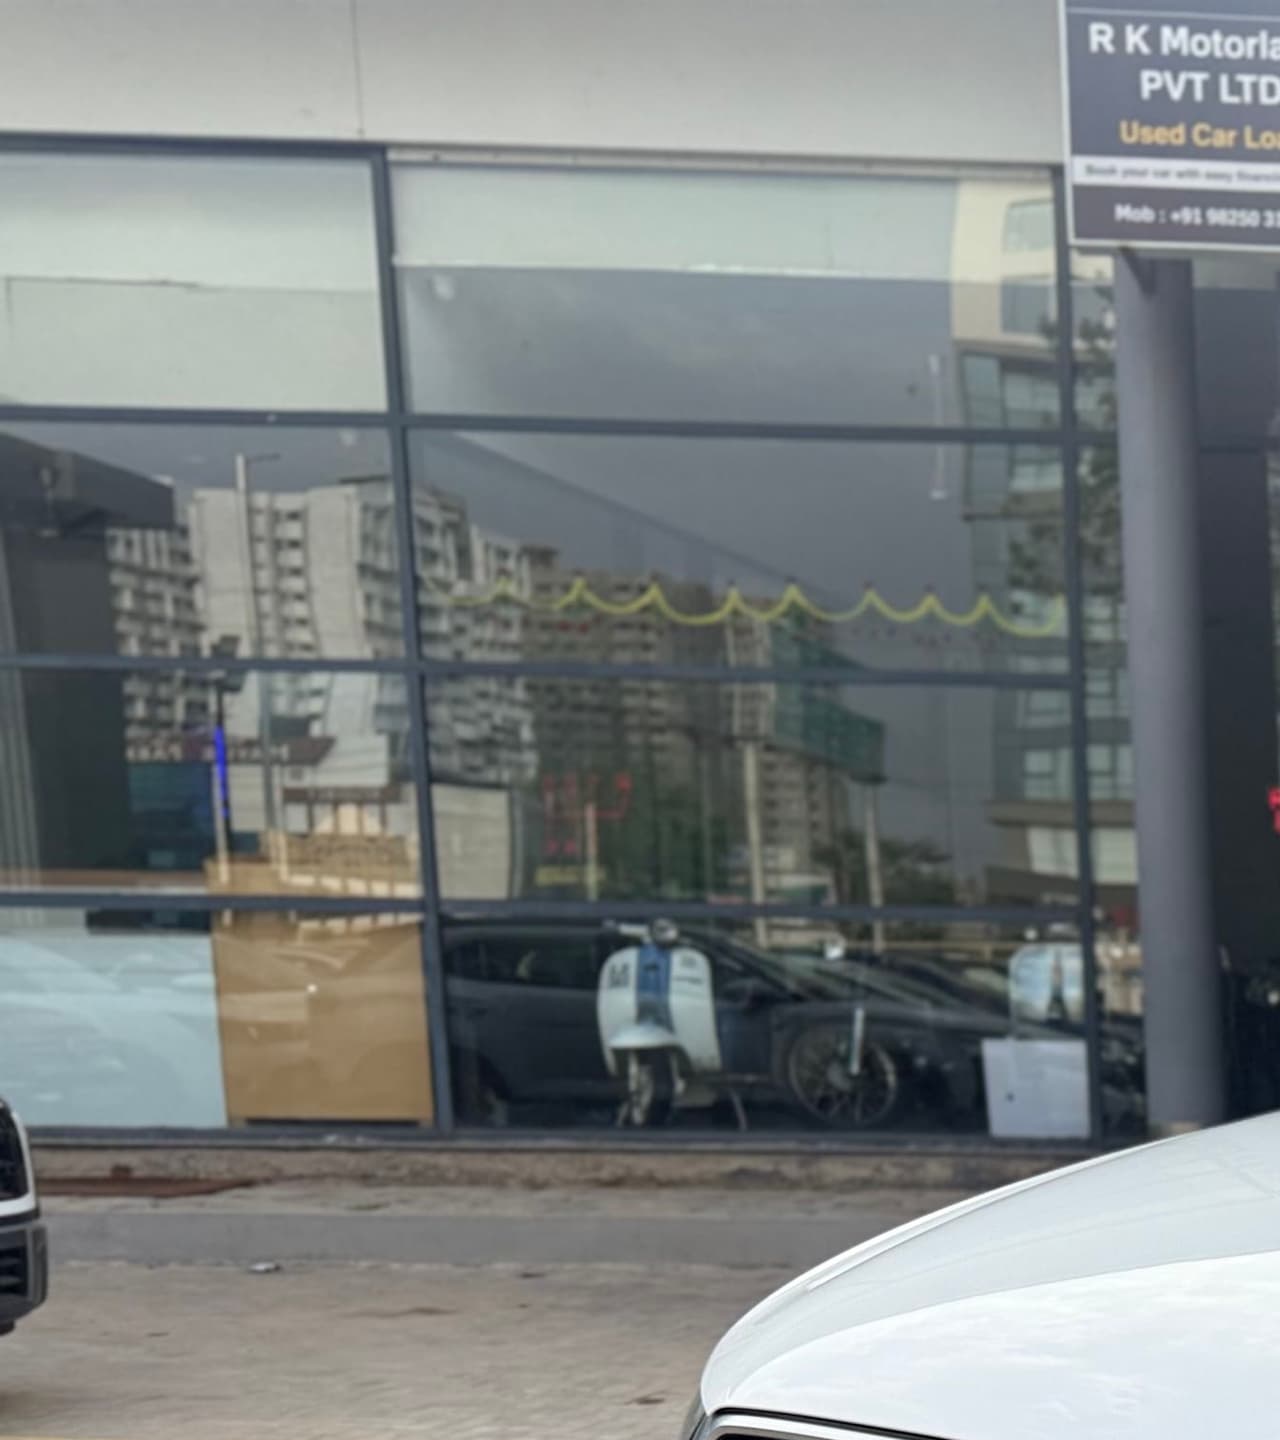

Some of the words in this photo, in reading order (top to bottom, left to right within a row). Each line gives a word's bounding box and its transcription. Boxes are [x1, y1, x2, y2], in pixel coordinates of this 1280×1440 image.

[1089, 22, 1114, 53] R
[1125, 24, 1151, 55] K
[1140, 70, 1210, 101] PVT
[1120, 121, 1186, 146] Used
[1192, 123, 1237, 148] Car
[1114, 203, 1156, 224] Mob
